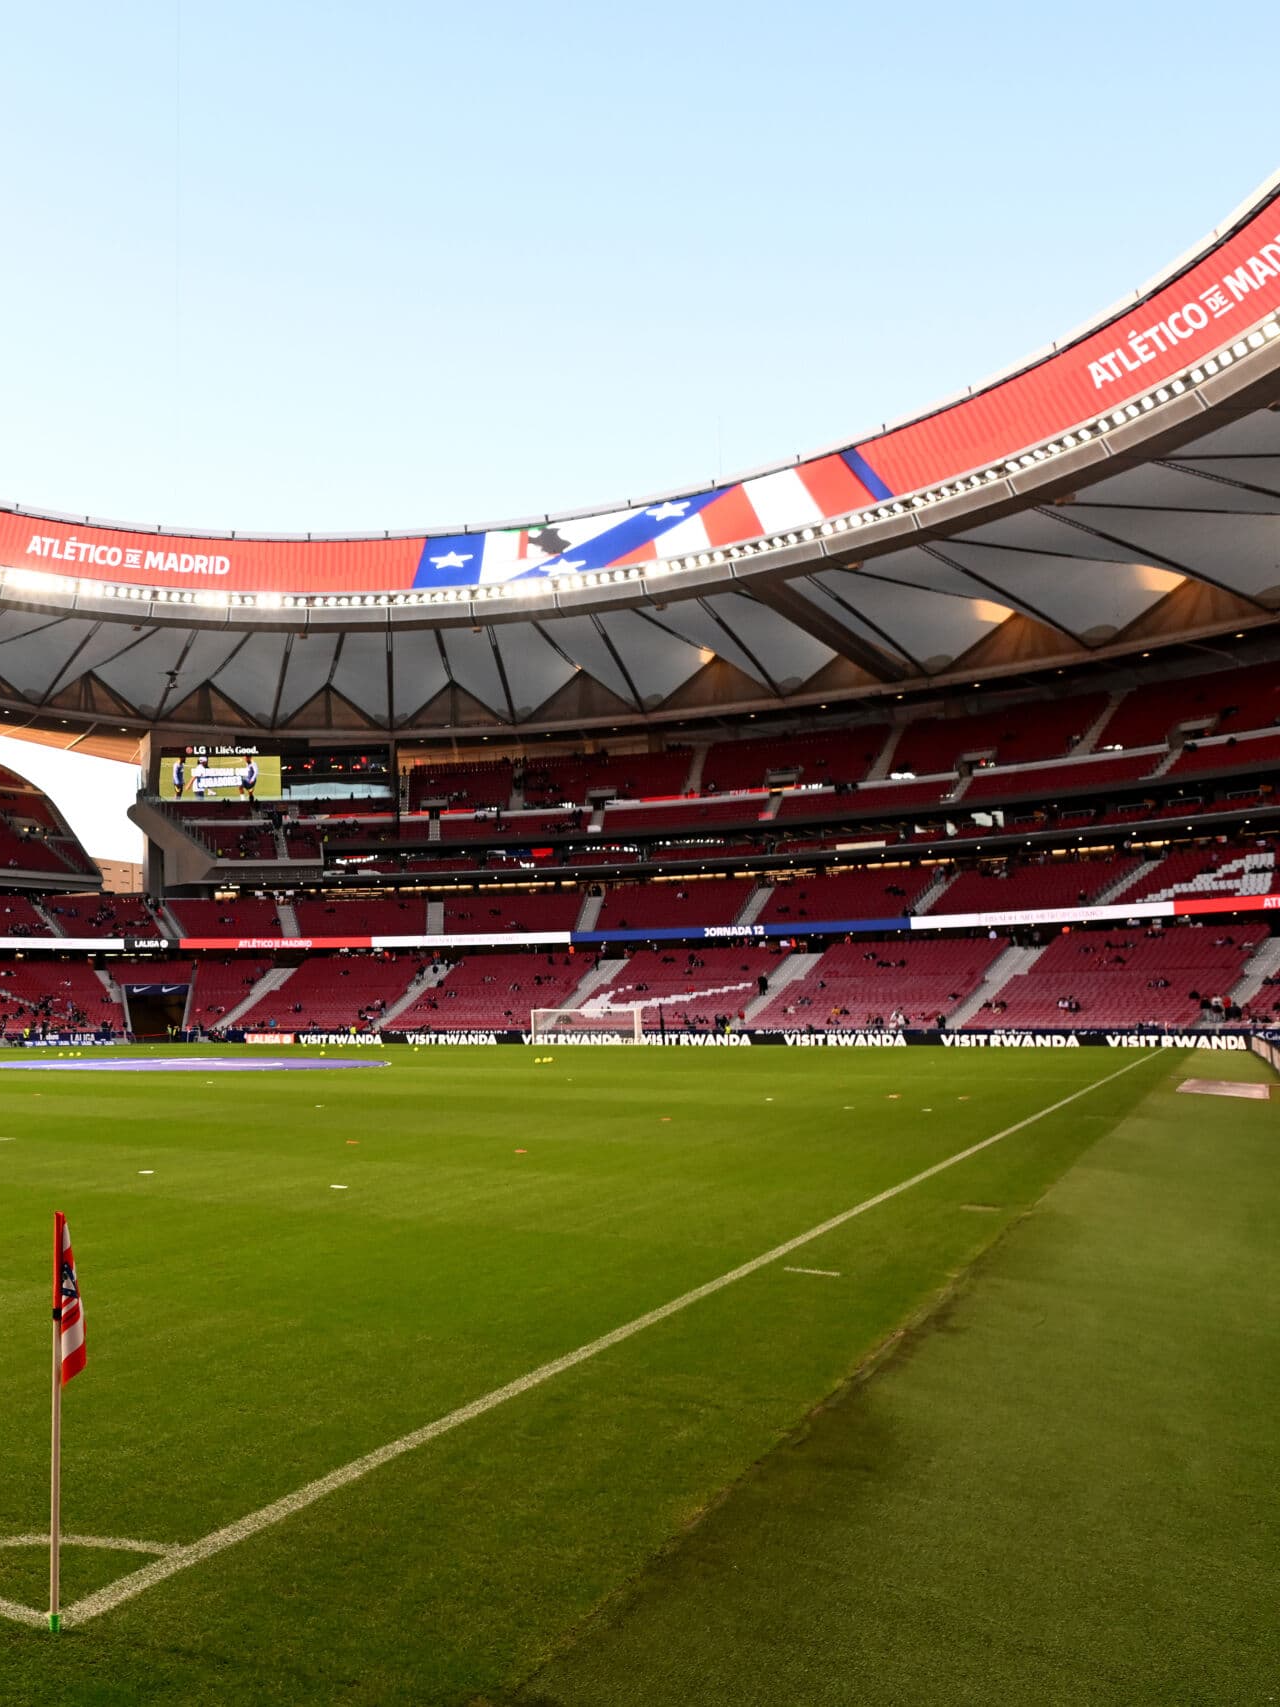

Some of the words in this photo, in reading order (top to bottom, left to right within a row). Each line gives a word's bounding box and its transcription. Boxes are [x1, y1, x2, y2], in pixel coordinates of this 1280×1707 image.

[1087, 303, 1208, 389] ATLÉTICO
[1205, 292, 1228, 312] DE
[1223, 234, 1280, 302] MAD
[26, 535, 123, 567] ATLÉTICO
[143, 550, 230, 575] MADRID
[193, 745, 206, 755] LG
[235, 745, 260, 754] Good.
[704, 926, 752, 937] JORNADA
[753, 925, 765, 935] 12
[134, 940, 159, 948] LALIGA
[281, 940, 312, 948] MADRID
[299, 1034, 328, 1044] VISIT
[329, 1034, 383, 1044] RWANDA
[406, 1034, 438, 1045] VISIT
[438, 1034, 497, 1045] RWANDA
[558, 1034, 621, 1045] RWANDA
[680, 1034, 752, 1046] RWANDA
[784, 1034, 826, 1046] VISIT
[827, 1034, 907, 1046] RWANDA
[940, 1035, 988, 1047] VISIT
[989, 1035, 1080, 1047] RWANDA
[1105, 1035, 1159, 1049] VISIT
[1161, 1035, 1247, 1049] RWANDA
